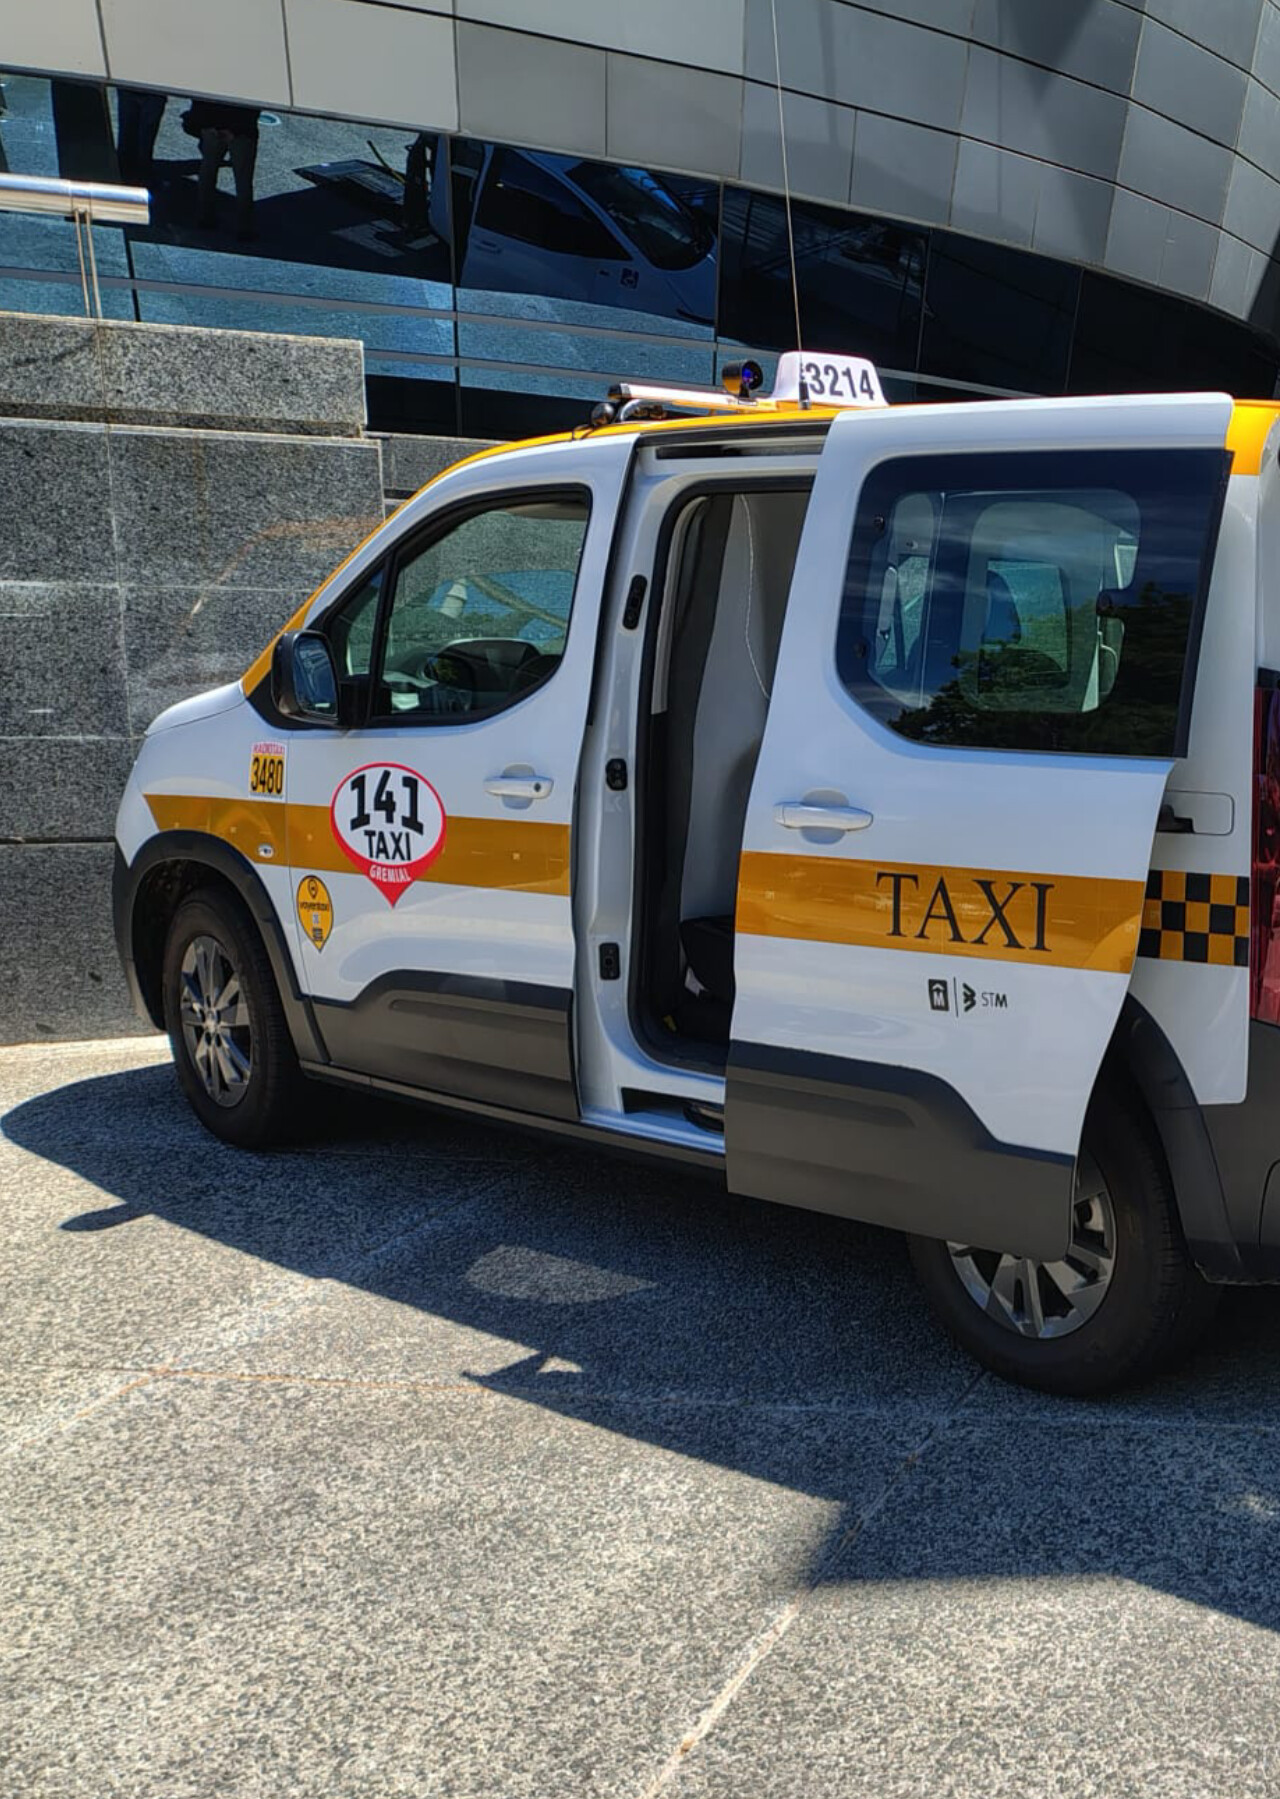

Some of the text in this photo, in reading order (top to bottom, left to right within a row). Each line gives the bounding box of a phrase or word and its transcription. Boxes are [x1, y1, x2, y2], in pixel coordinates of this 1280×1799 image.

[805, 362, 874, 400] 3214
[251, 757, 284, 794] 3480
[350, 769, 424, 836] 141
[364, 830, 411, 861] TAXI
[370, 865, 411, 883] GREMIAL
[876, 872, 1055, 952] TAXI
[981, 992, 1008, 1008] STM
